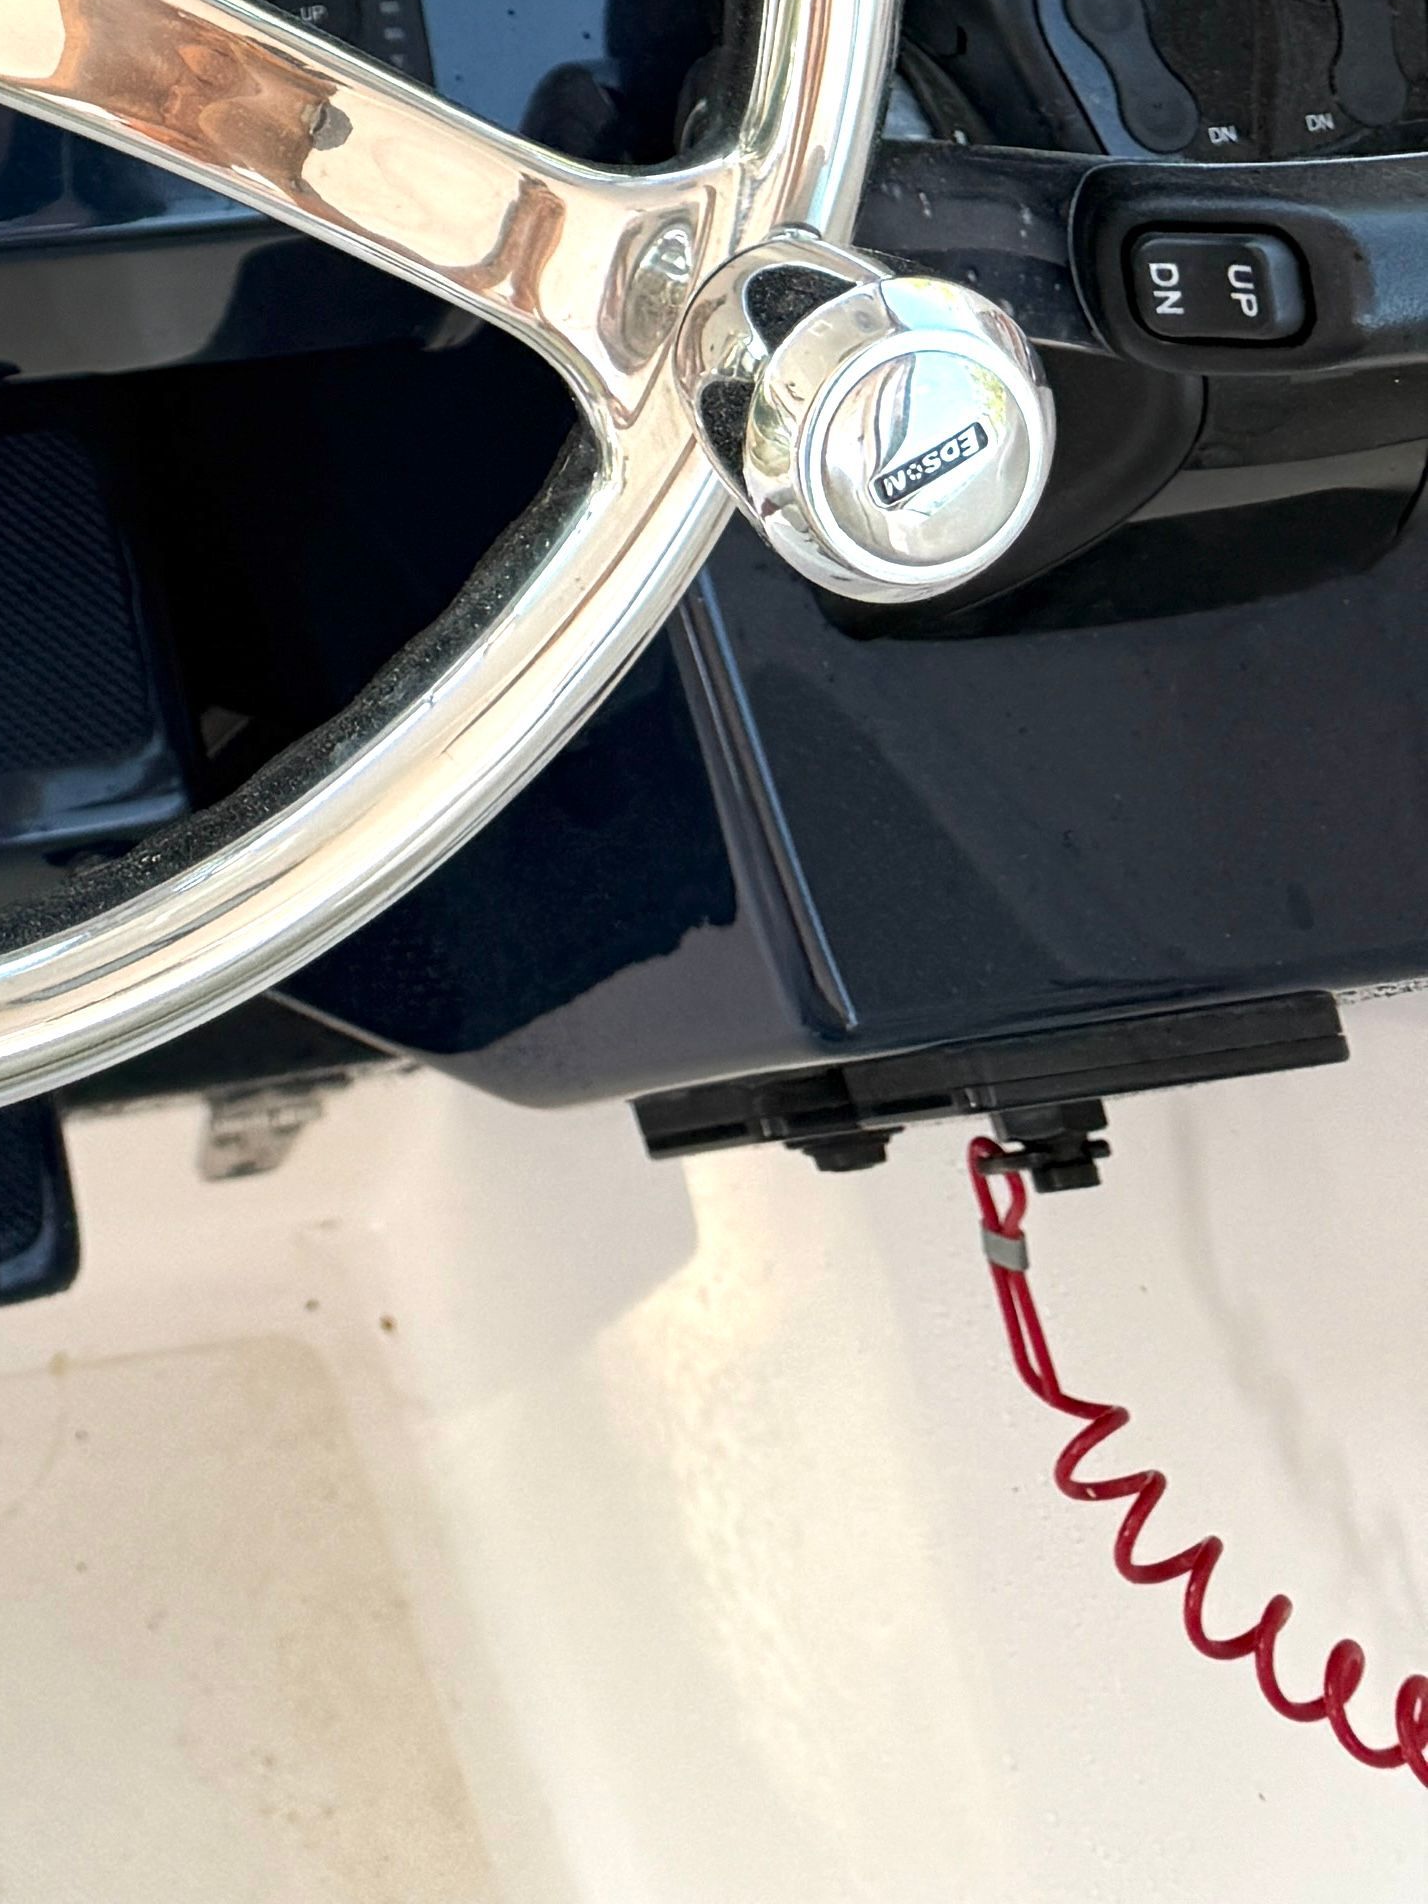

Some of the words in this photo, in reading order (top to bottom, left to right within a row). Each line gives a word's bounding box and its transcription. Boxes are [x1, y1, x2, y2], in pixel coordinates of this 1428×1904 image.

[299, 4, 329, 23] UP
[1305, 112, 1335, 133] DN
[1207, 124, 1240, 145] DN
[1148, 261, 1186, 318] DN
[1226, 263, 1260, 319] UP
